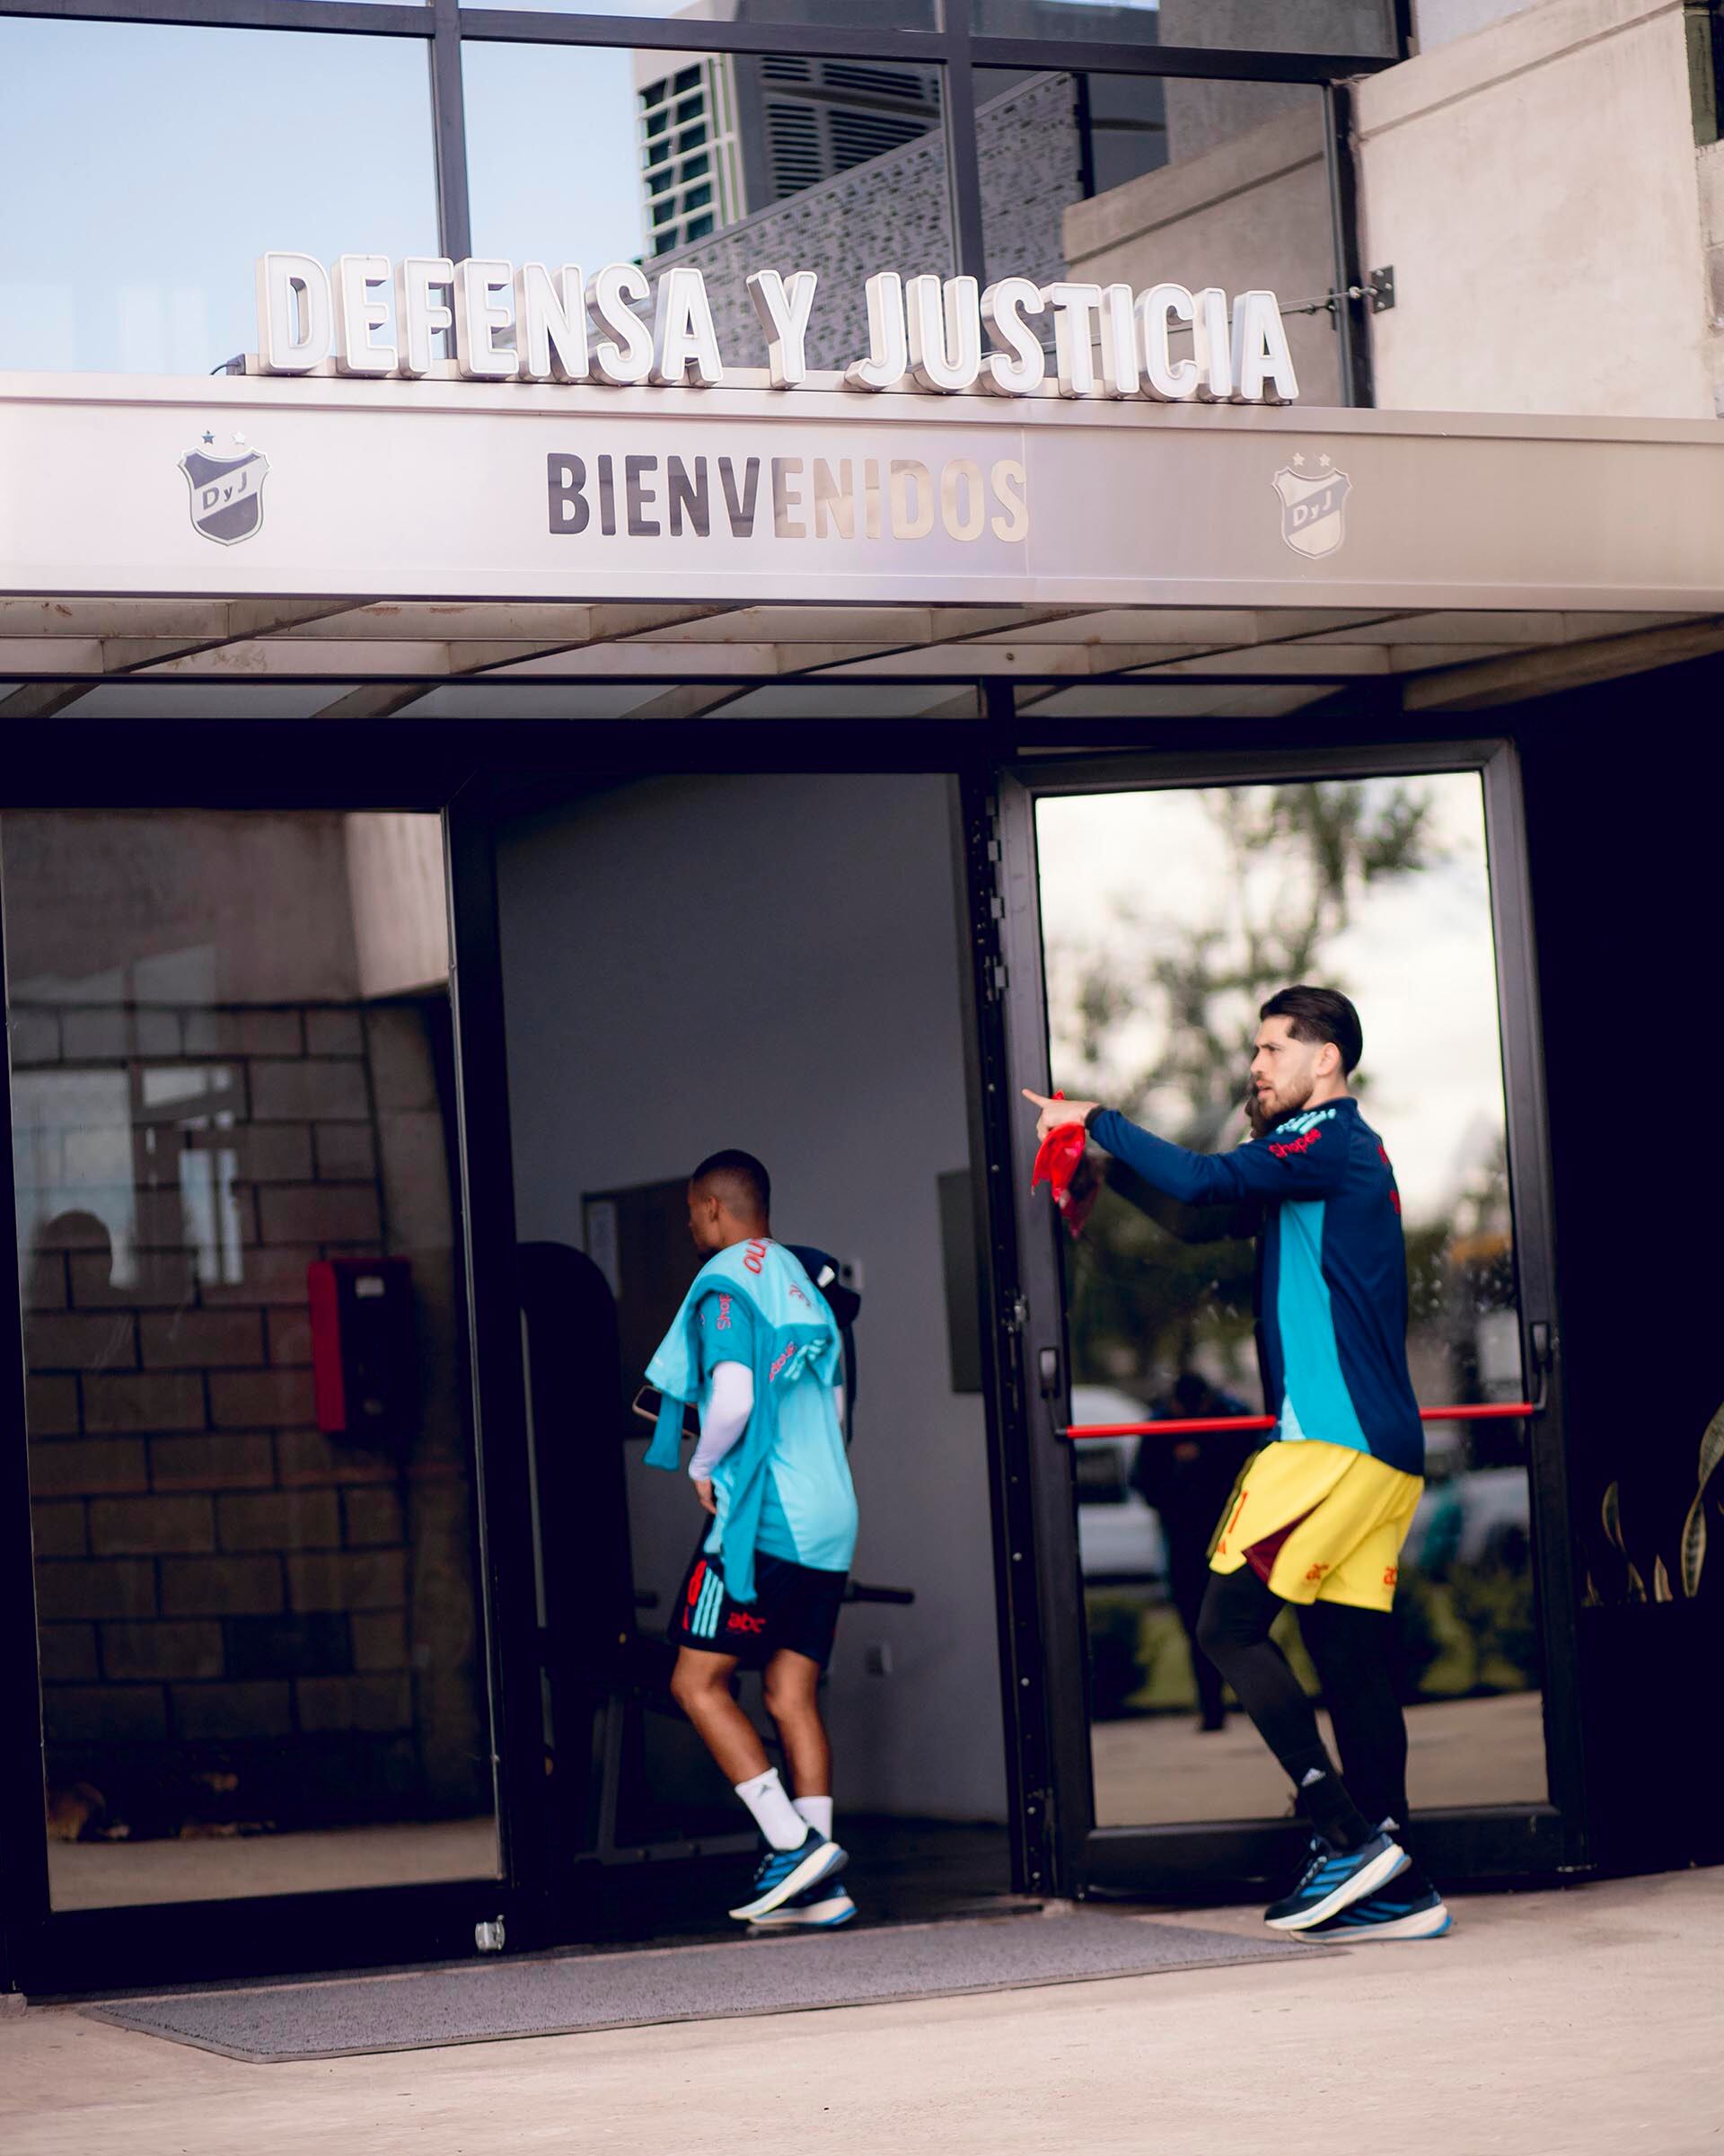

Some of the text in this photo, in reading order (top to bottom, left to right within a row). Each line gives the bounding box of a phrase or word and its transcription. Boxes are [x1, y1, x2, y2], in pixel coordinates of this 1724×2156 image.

[256, 251, 1299, 405] DEFENSA Y JUSTICIA
[547, 453, 1030, 542] BIENVENIDOS
[1268, 1128, 1322, 1158] Shopee
